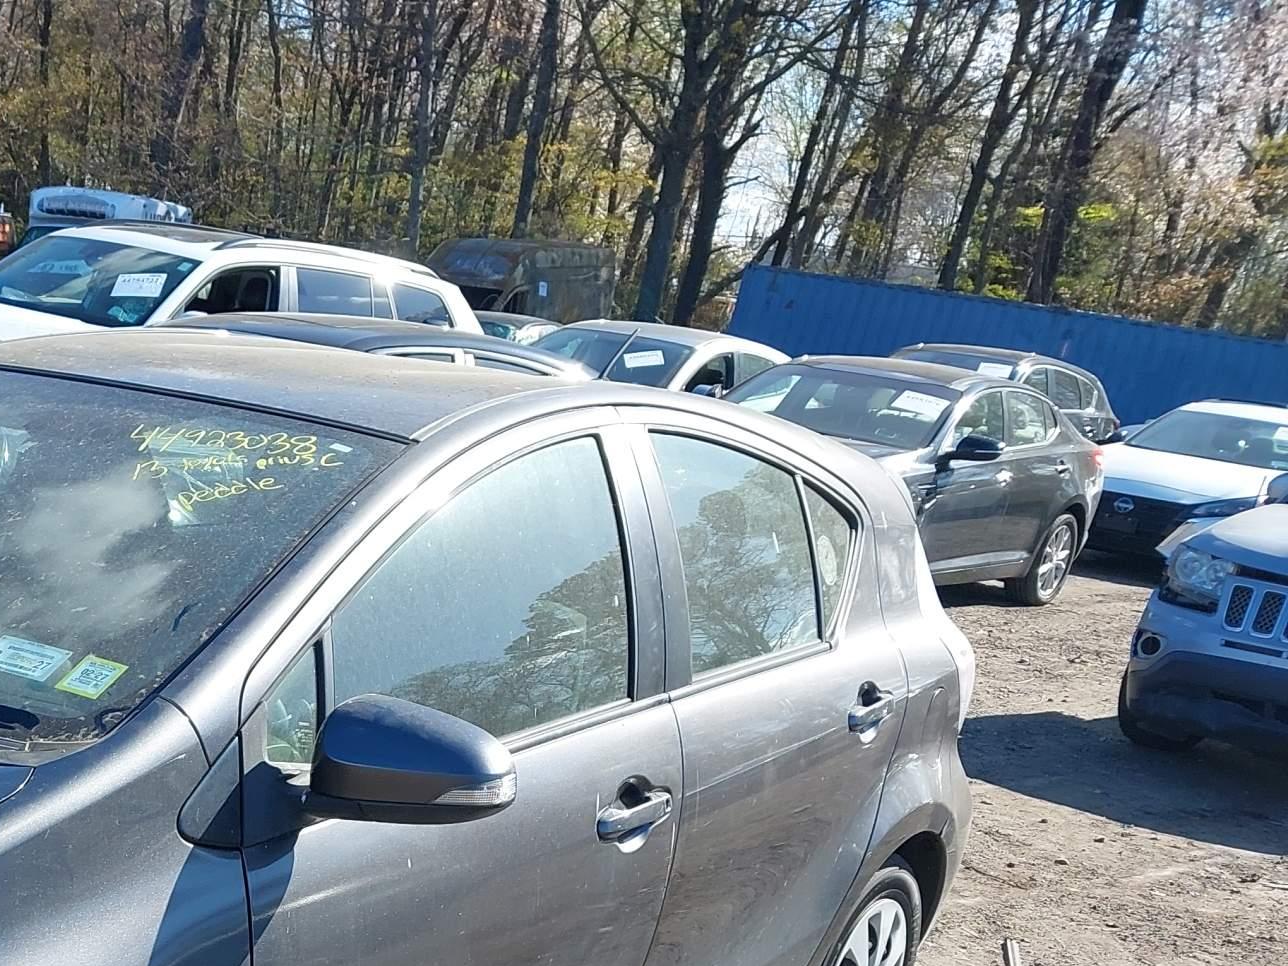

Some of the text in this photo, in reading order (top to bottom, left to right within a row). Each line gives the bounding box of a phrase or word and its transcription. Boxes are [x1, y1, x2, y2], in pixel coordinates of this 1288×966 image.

[130, 424, 318, 455] 44923038
[132, 461, 168, 480] 13
[32, 660, 52, 672] 27
